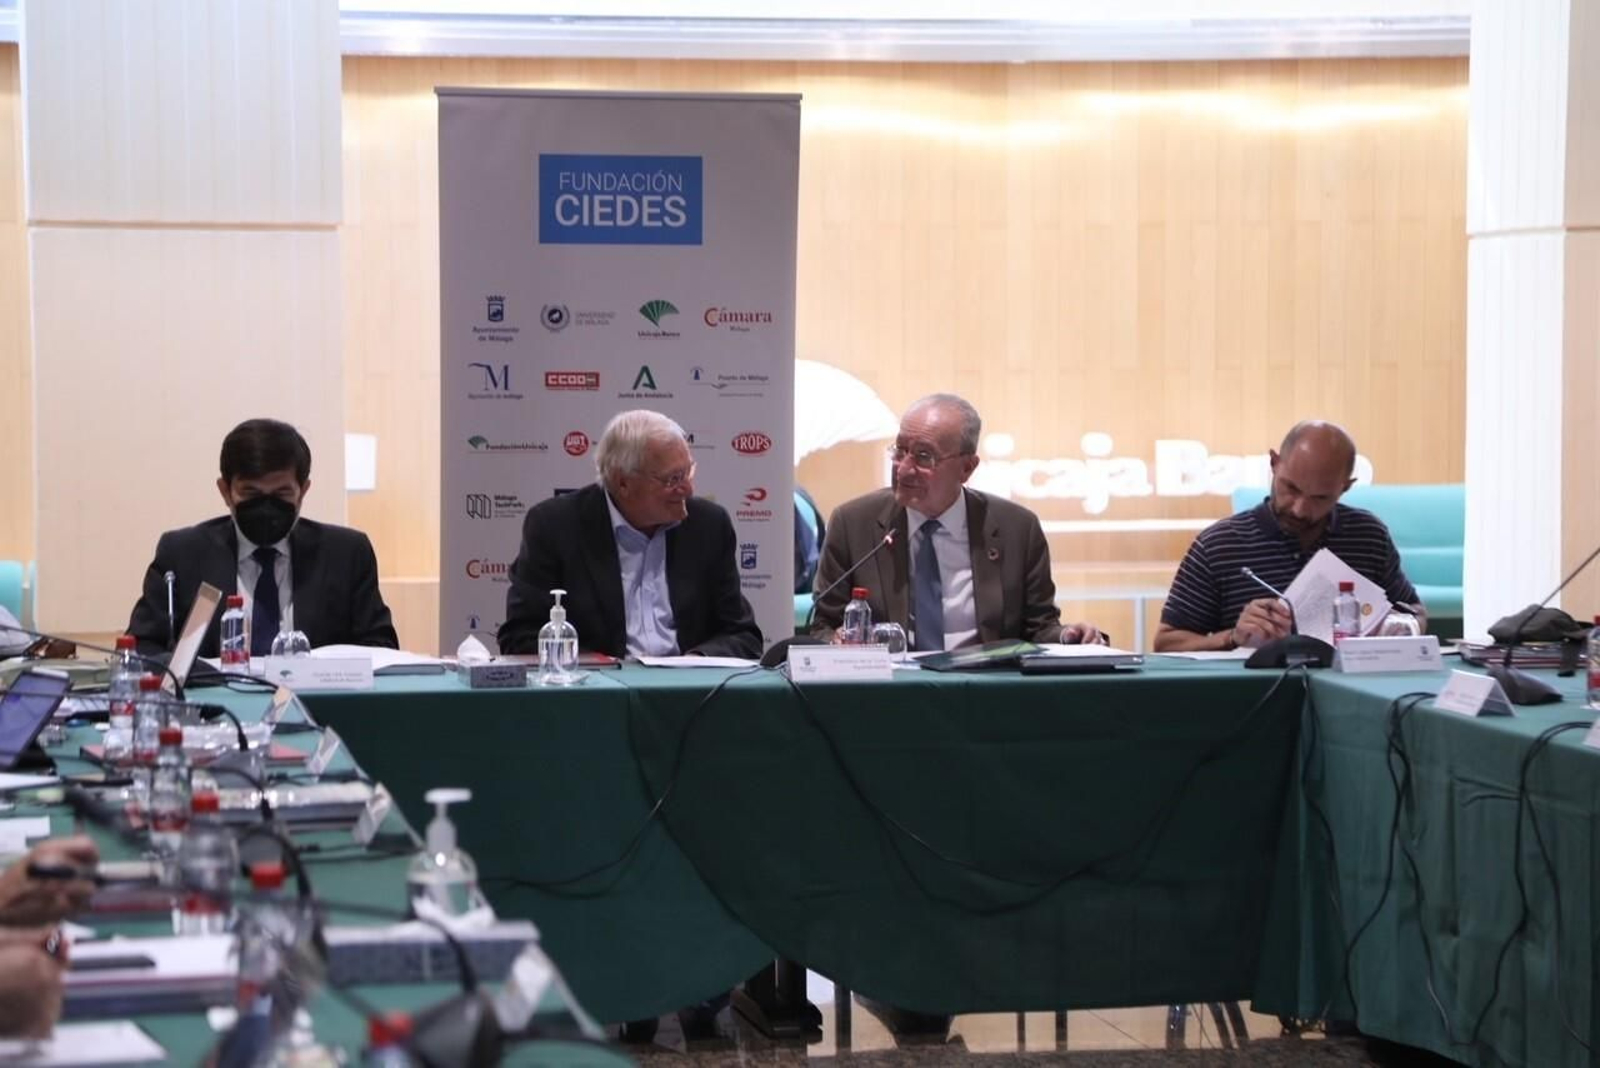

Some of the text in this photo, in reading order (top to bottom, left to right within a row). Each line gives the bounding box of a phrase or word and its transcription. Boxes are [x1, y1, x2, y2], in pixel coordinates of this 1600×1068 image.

[559, 169, 683, 192] FUNDACIÓN
[555, 193, 687, 227] CIEDES
[704, 306, 772, 327] Cámara
[547, 374, 586, 385] CCOO
[734, 434, 771, 451] TROPS
[465, 557, 508, 580] Cám
